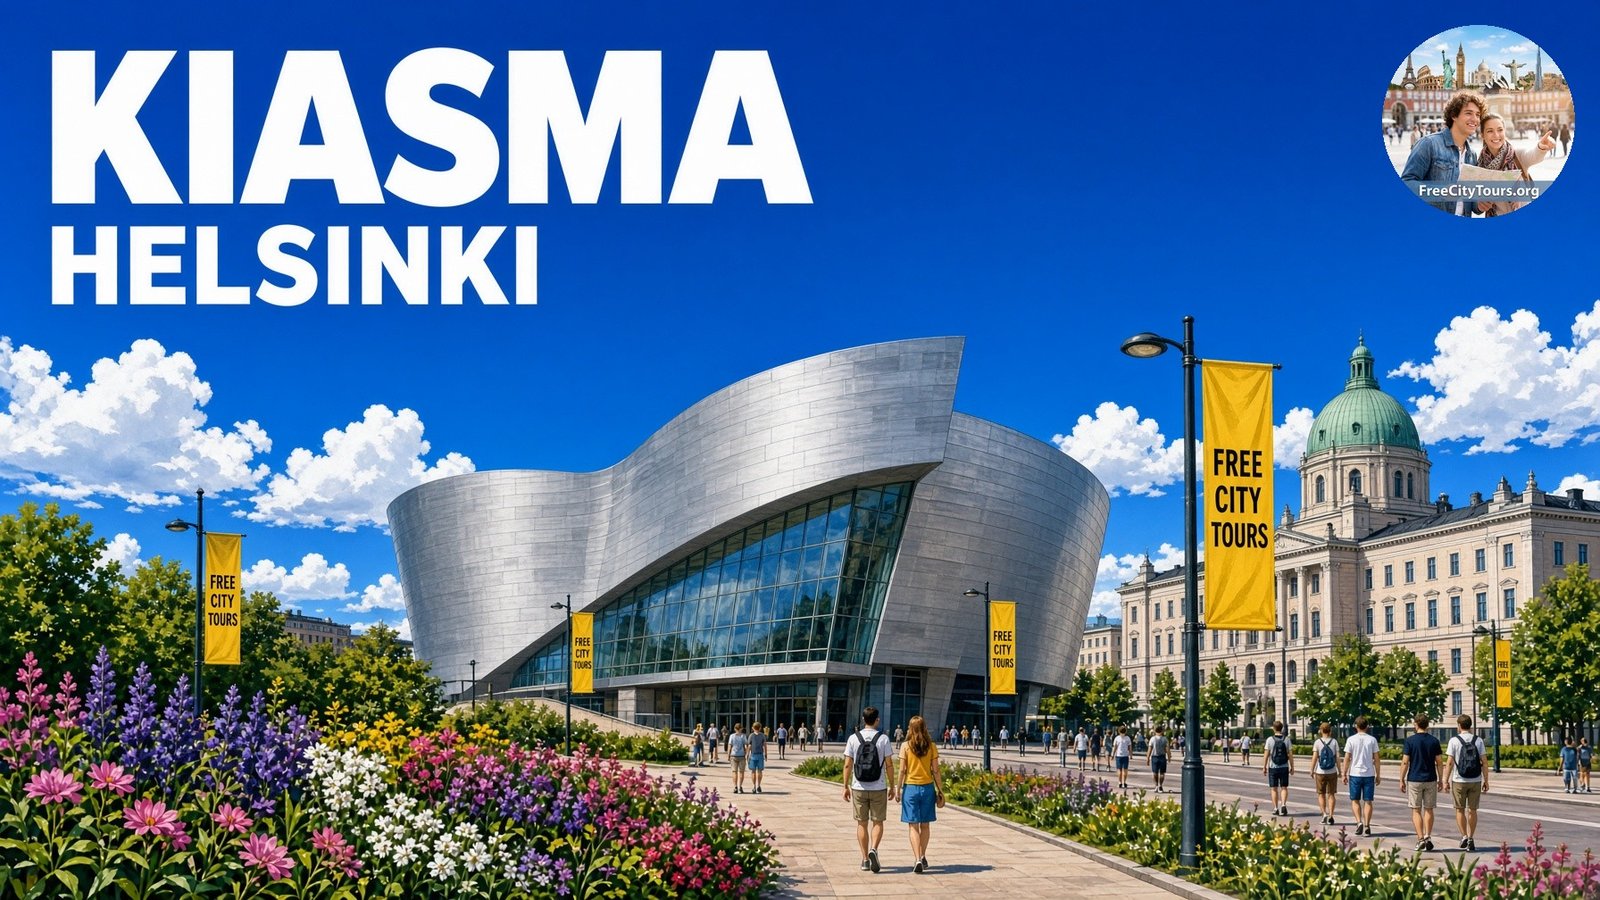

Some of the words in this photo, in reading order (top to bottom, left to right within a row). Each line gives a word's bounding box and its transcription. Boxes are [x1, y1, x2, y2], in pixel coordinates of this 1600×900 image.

[1213, 448, 1263, 478] FREE
[1215, 485, 1262, 514] CITY
[1211, 521, 1269, 549] TOURS
[210, 574, 236, 590] FREE
[210, 593, 234, 609] CITY
[207, 612, 238, 627] TOURS
[574, 637, 591, 647] FREE
[993, 630, 1013, 642] FREE
[575, 649, 590, 658] CITY
[994, 643, 1012, 656] CITY
[574, 660, 592, 670] TOURS
[993, 657, 1014, 669] TOURS
[1497, 670, 1509, 679] CITY
